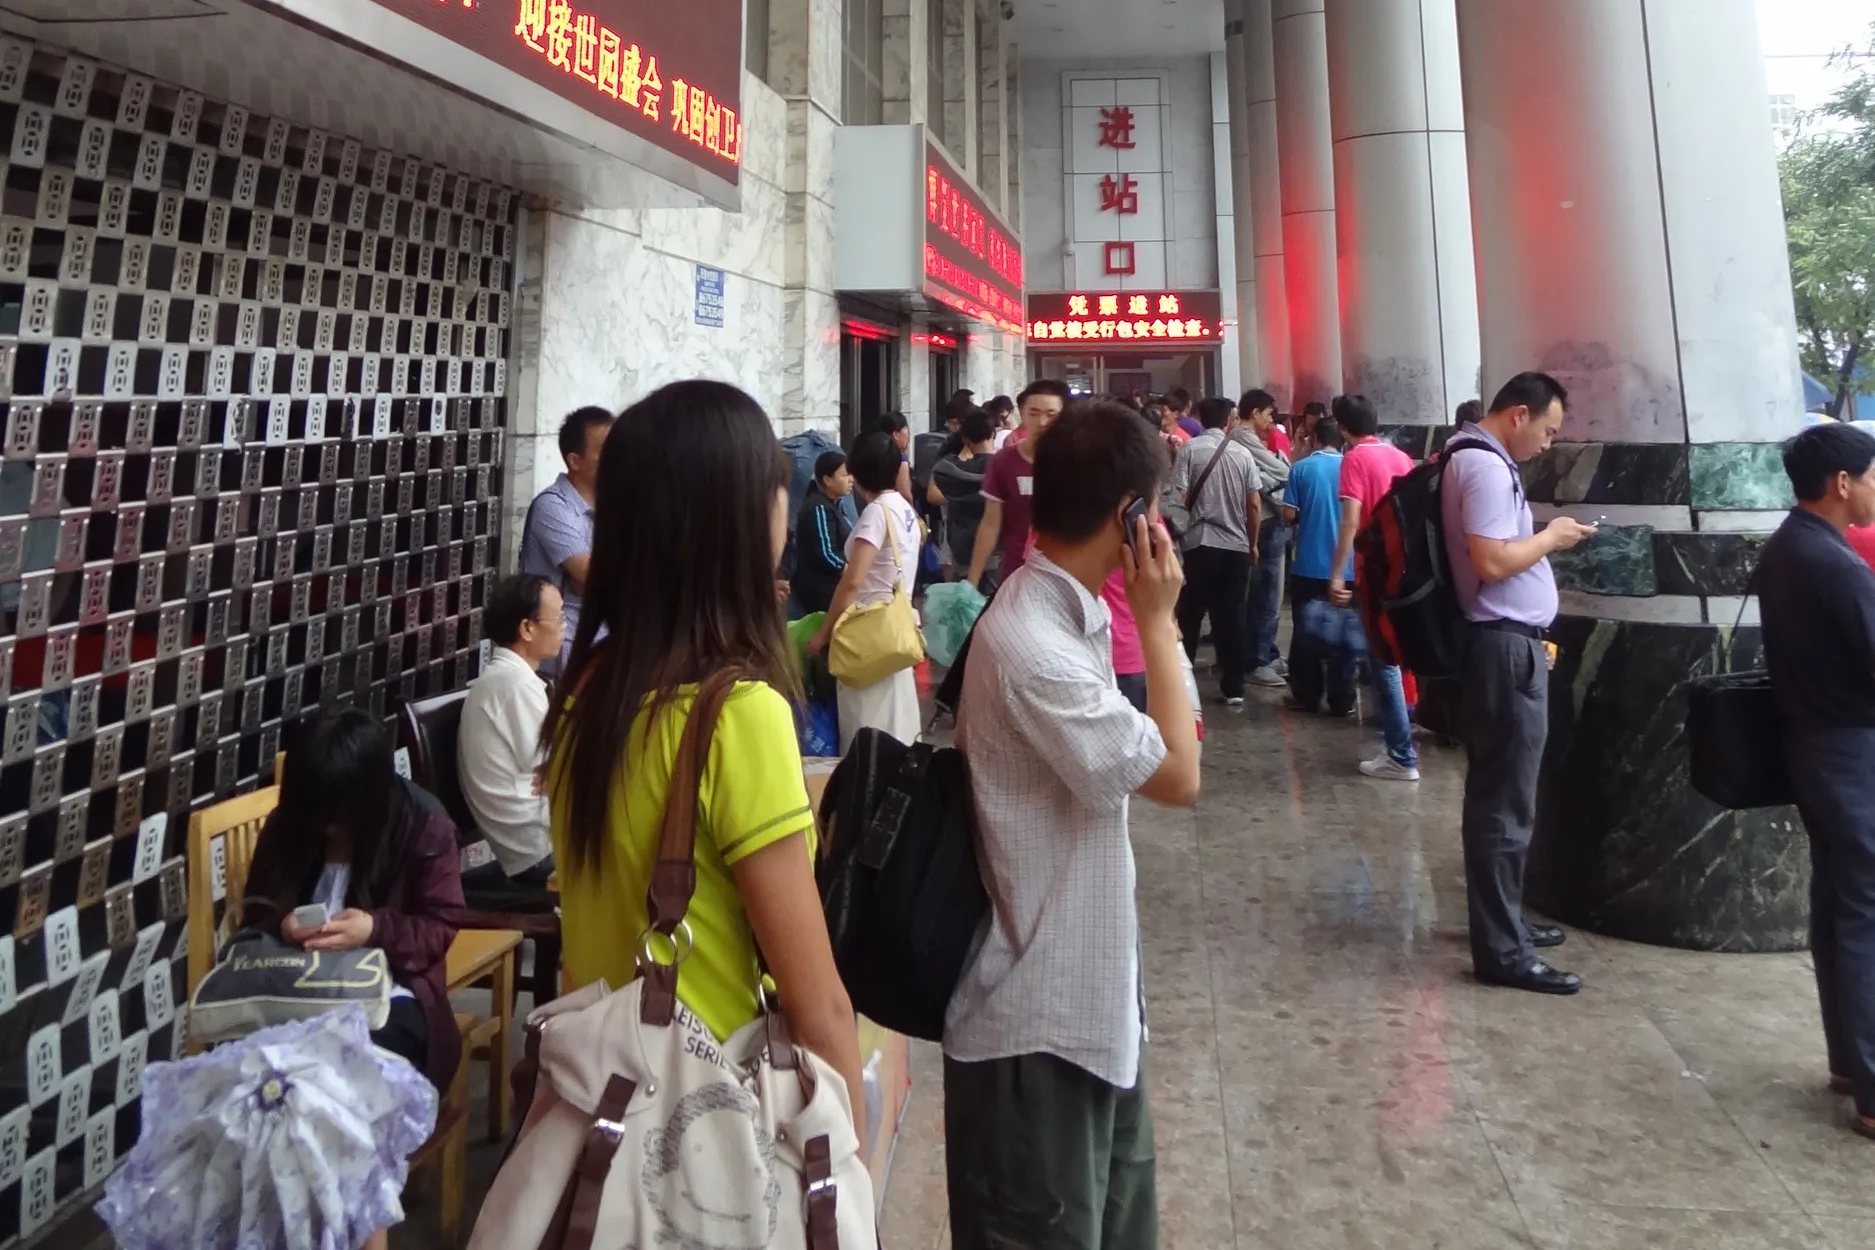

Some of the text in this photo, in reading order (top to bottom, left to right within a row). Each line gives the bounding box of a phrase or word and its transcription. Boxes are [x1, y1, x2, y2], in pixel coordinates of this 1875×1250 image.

[670, 78, 742, 164] 巩固创卫
[1098, 106, 1138, 275] 进站口
[1026, 318, 1224, 339] 自觉接受行包安全检查。
[1068, 294, 1179, 316] 凭票进站
